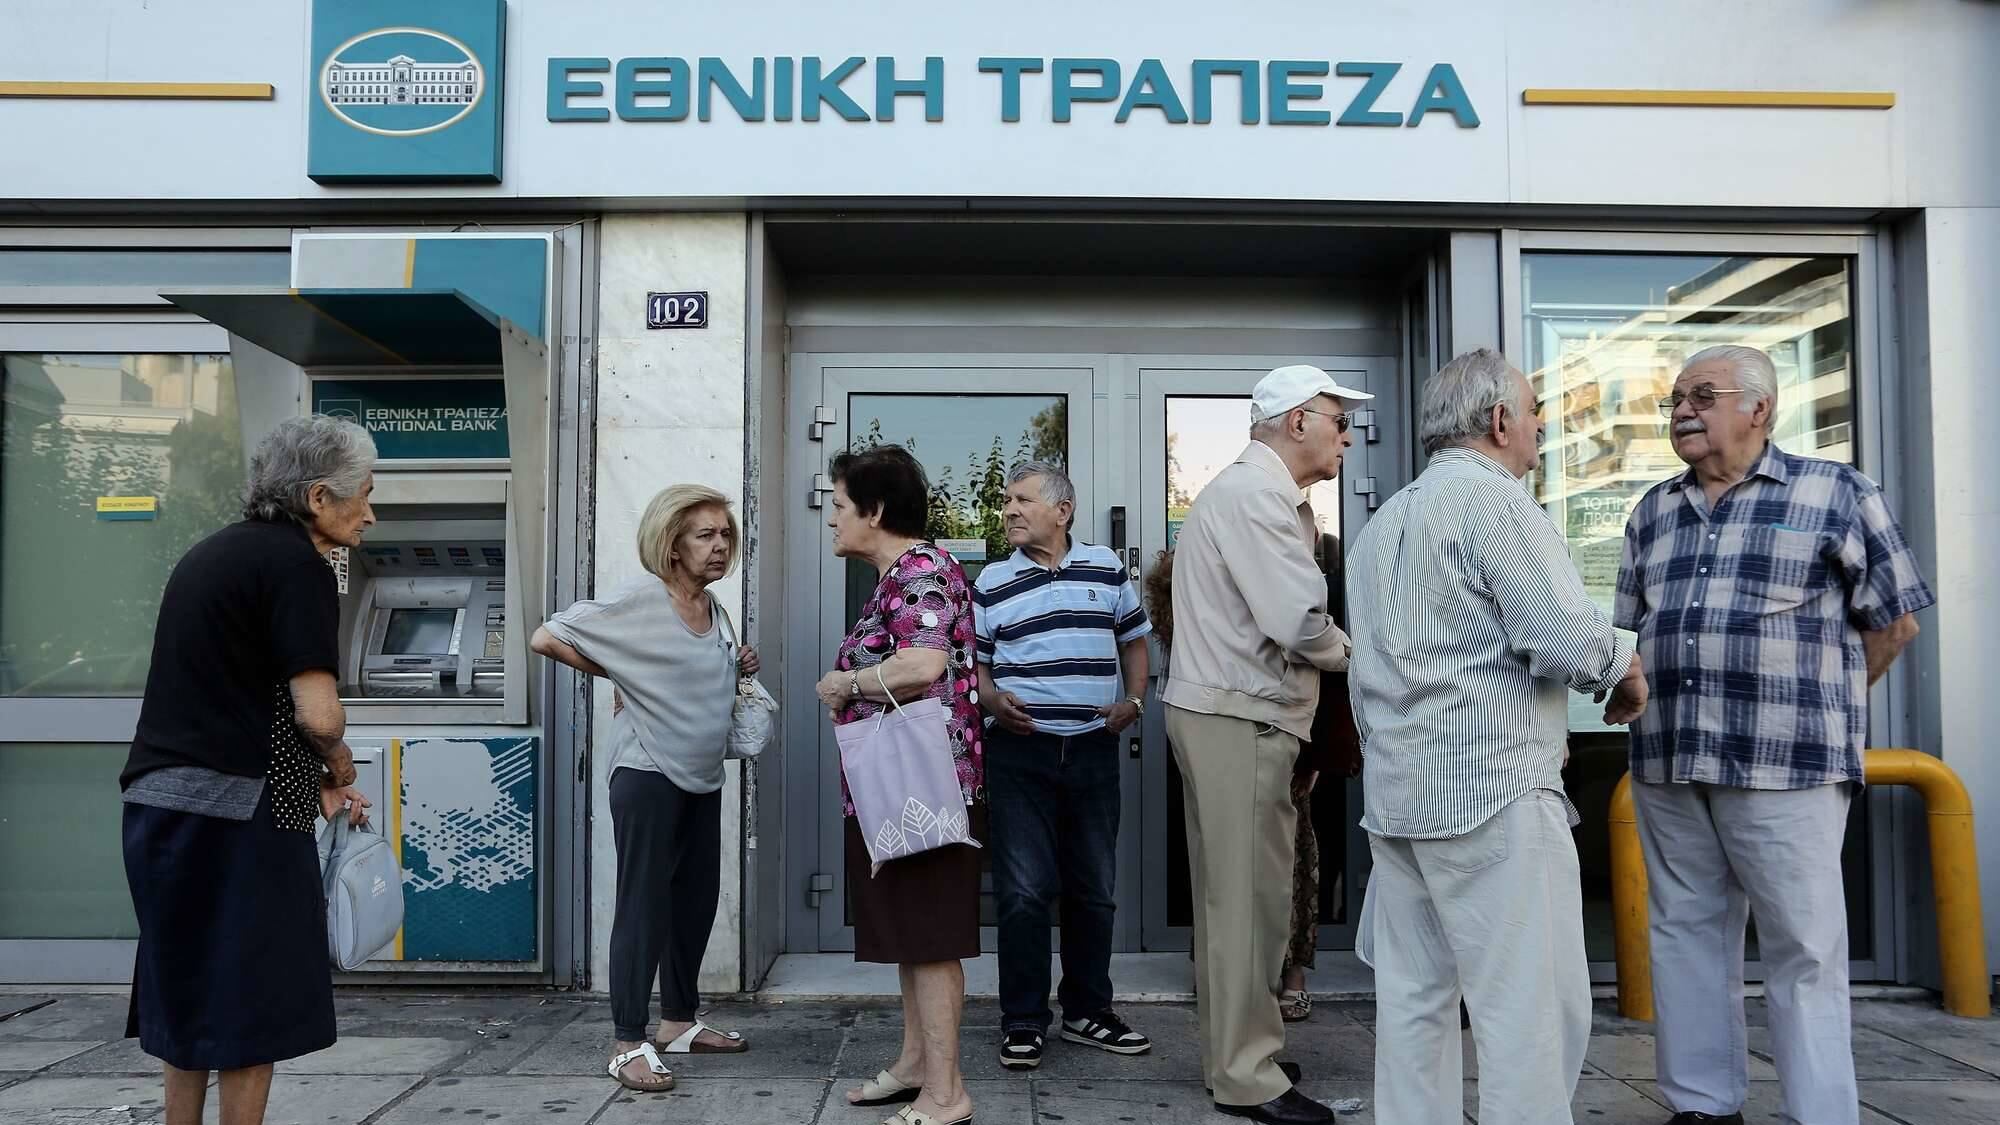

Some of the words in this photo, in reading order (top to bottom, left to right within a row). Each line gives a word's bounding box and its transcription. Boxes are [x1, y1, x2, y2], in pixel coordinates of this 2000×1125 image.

[546, 56, 945, 122] ΕΘΝΙΚΗ
[978, 57, 1481, 128] ΤΡΑΠΕΖΑ
[653, 297, 699, 323] 102
[366, 408, 429, 420] ΕΘΝΙΚΗ
[433, 408, 508, 419] ΤΡΑΠΕΖΑ
[366, 420, 447, 432] NATIONAL
[452, 420, 497, 431] BANK
